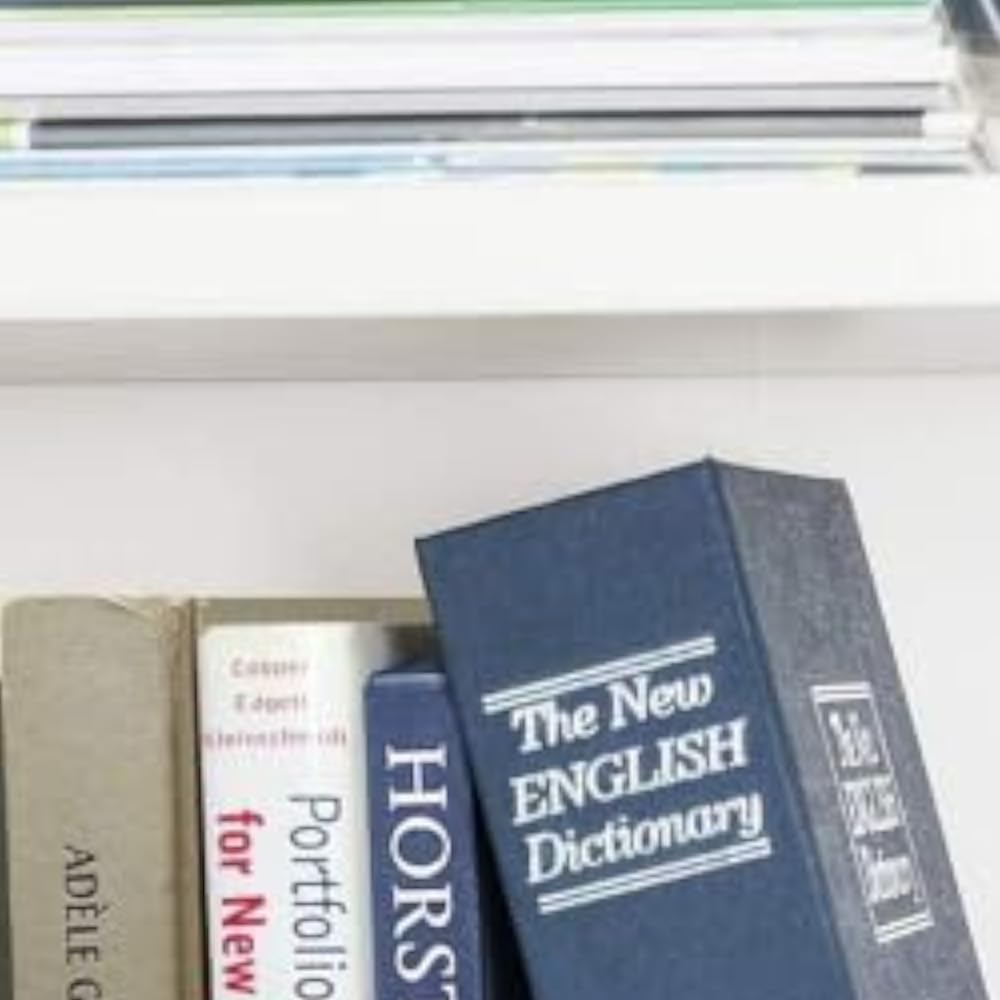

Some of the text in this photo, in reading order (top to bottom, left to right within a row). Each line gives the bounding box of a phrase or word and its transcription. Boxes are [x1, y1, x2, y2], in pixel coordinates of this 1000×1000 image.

[511, 673, 712, 752] The New
[510, 719, 748, 824] ENGLISH
[216, 808, 264, 875] for
[524, 793, 763, 884] Dictionary
[64, 845, 108, 963] ADÈLE
[222, 896, 267, 993] New
